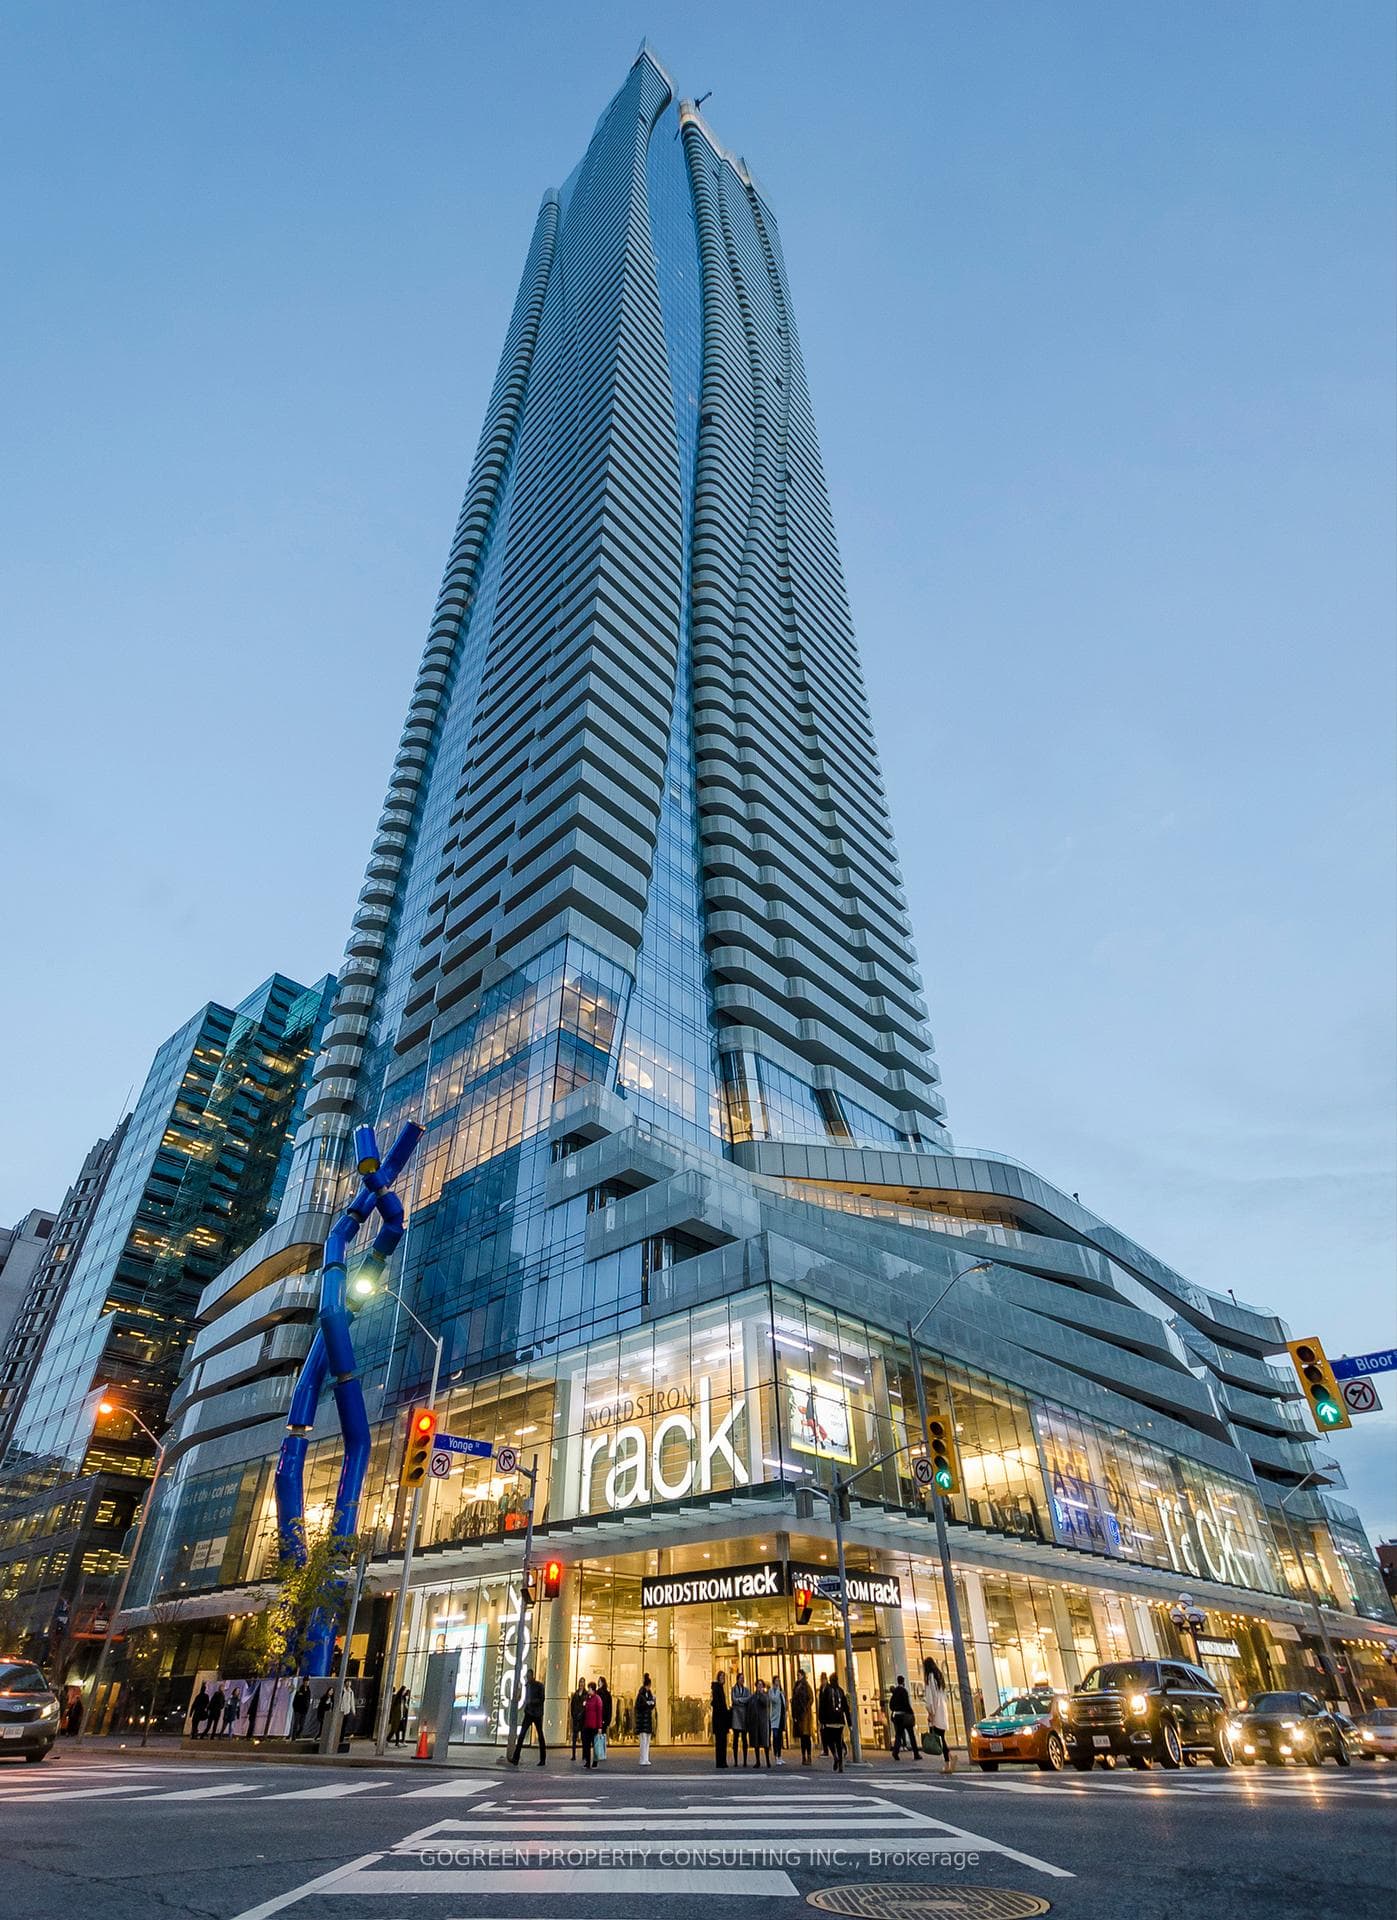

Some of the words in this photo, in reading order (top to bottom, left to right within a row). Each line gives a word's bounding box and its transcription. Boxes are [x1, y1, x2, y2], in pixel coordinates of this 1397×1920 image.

[1355, 1355, 1392, 1371] Bloor
[585, 1384, 697, 1429] NORDSTROM
[448, 1437, 474, 1453] Yonge
[579, 1376, 749, 1514] rack
[1156, 1488, 1251, 1587] rack
[643, 1577, 732, 1606] NORDSTROM
[734, 1565, 778, 1597] rack
[793, 1572, 869, 1600] NORROM
[869, 1579, 900, 1605] rack
[490, 1623, 506, 1735] NORDSTROM
[497, 1585, 533, 1736] rack
